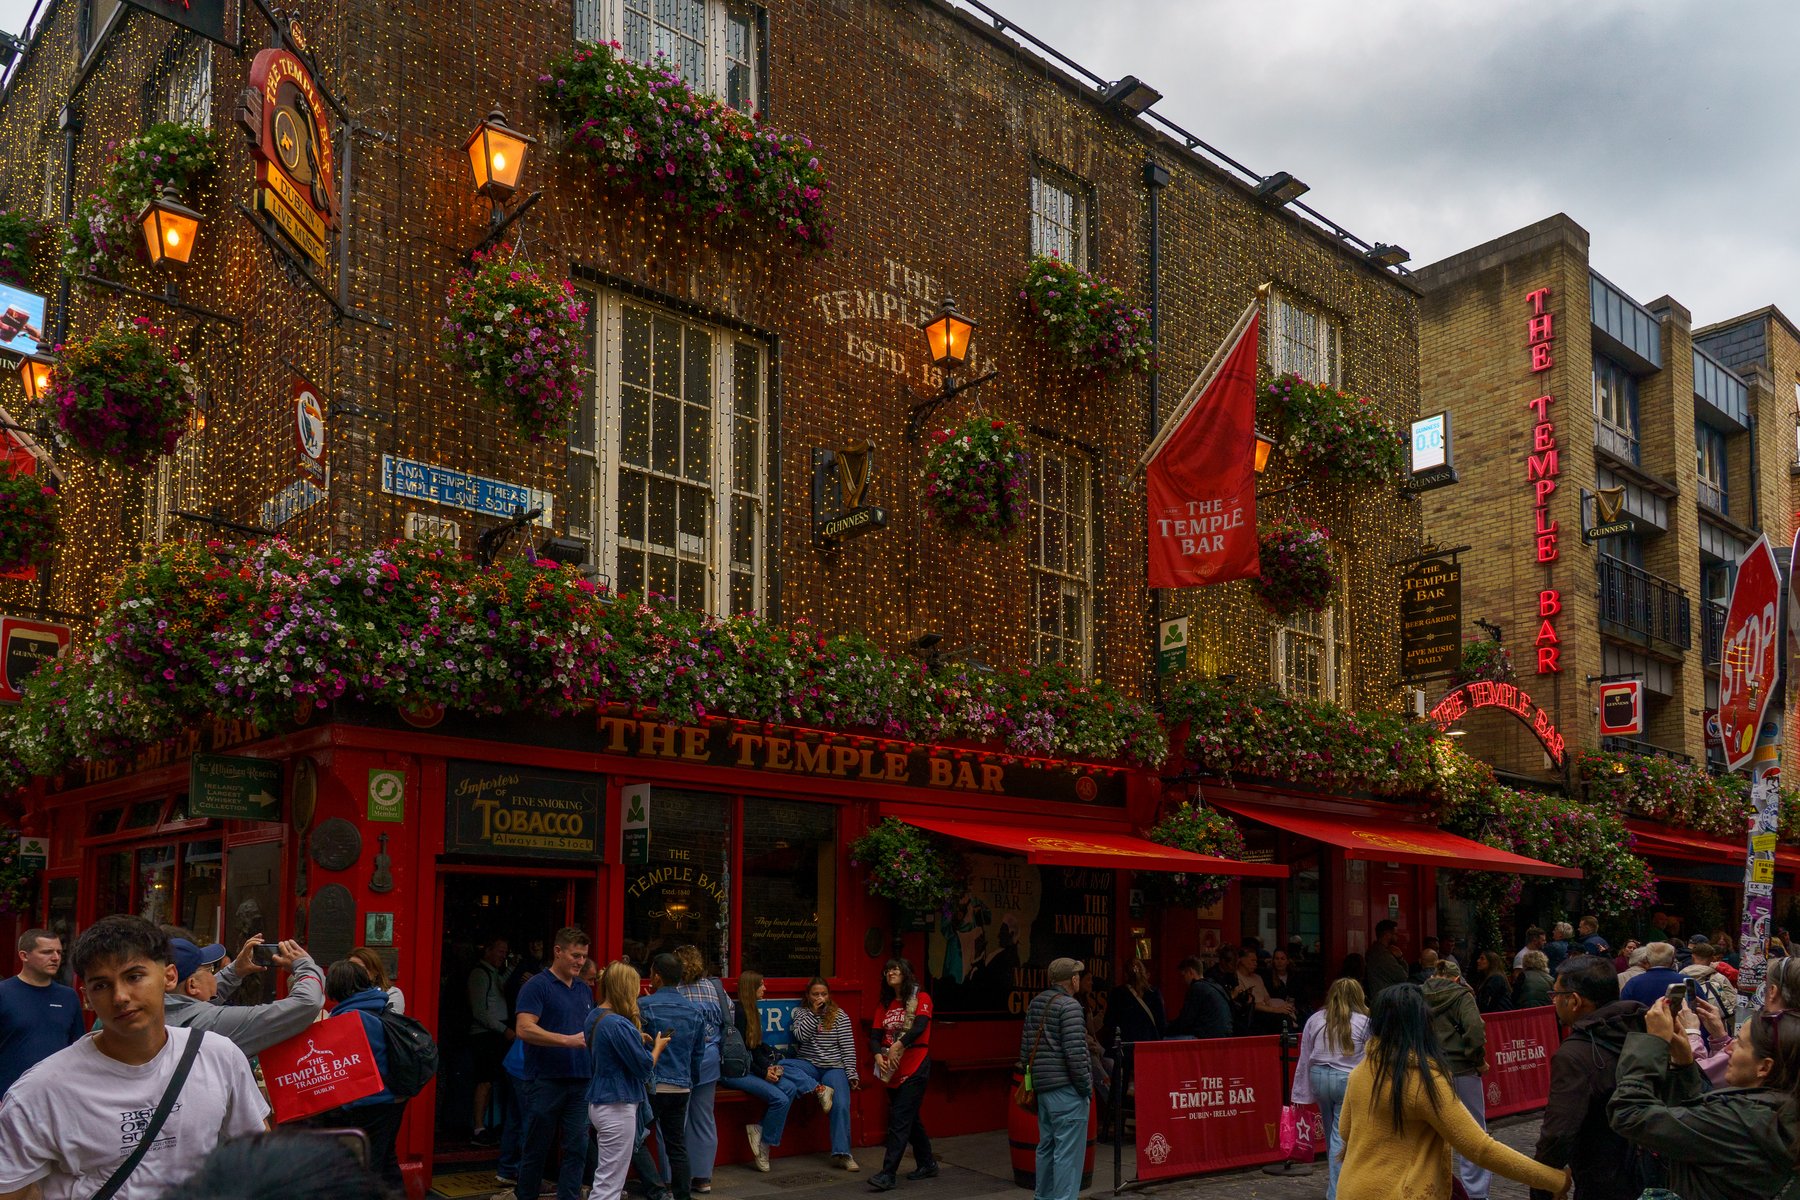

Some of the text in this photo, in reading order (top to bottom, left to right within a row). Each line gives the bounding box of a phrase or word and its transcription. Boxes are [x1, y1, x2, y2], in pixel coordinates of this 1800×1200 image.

[266, 63, 281, 106] THE
[279, 58, 322, 119] TEMPLE
[319, 126, 330, 174] BAR
[280, 179, 315, 227] DUBLIN
[272, 198, 322, 261] LIVE MUSIC
[884, 257, 939, 305] THE
[813, 289, 935, 332] TEMPLE
[1416, 423, 1441, 434] GUINNESS
[1416, 430, 1441, 451] 0.0
[430, 471, 481, 493] TEMPLE
[487, 484, 527, 503] THEAS
[1409, 472, 1451, 489] GUINNESS
[1525, 287, 1564, 675] THE TEMPLE BAR
[386, 475, 439, 497] TEMPLE
[445, 488, 480, 507] LANE
[1186, 499, 1223, 516] THE
[826, 510, 870, 536] GUINNESS
[1157, 507, 1244, 537] TEMPLE
[1589, 523, 1629, 537] GUINNESS
[1182, 534, 1225, 555] BAR
[1423, 564, 1440, 575] THE
[1404, 571, 1459, 591] TEMPLE
[1416, 588, 1446, 602] BAR
[1405, 613, 1457, 629] BEER GARDEN
[1407, 644, 1455, 658] LIVE MUSIC
[1418, 655, 1443, 665] DAILY
[1722, 601, 1775, 706] STOP
[1430, 680, 1565, 765] THE TEMPLE BAR
[600, 716, 1006, 793] THE TEMPLE BAR
[208, 790, 241, 798] LARGEST
[455, 774, 521, 799] Importers
[496, 789, 507, 797] OF
[200, 802, 247, 812] COLLECTION
[375, 804, 397, 812] Official
[512, 796, 583, 811] FINE SMOKING
[472, 798, 584, 840] TOBACCO
[495, 835, 593, 849] Always in Stock
[668, 848, 690, 860] THE
[993, 863, 1021, 879] THE
[628, 866, 725, 904] TEMPLE BAR
[980, 877, 1033, 896] TEMPLE
[994, 894, 1022, 911] BAR
[1083, 894, 1108, 914] THE
[1055, 914, 1108, 935] EMPEROR
[1094, 936, 1107, 956] OF
[1511, 1039, 1526, 1049] THE
[308, 1056, 325, 1067] THE
[1495, 1046, 1546, 1065] TEMPLE BAR
[275, 1053, 361, 1087] TEMPLE BAR
[295, 1068, 348, 1089] TRADING CO.
[314, 1085, 335, 1096] DUBLIN
[1201, 1077, 1223, 1089] THE
[1169, 1087, 1256, 1110] TEMPLE BAR
[1188, 1109, 1238, 1120] DUBLIN IRELAND
